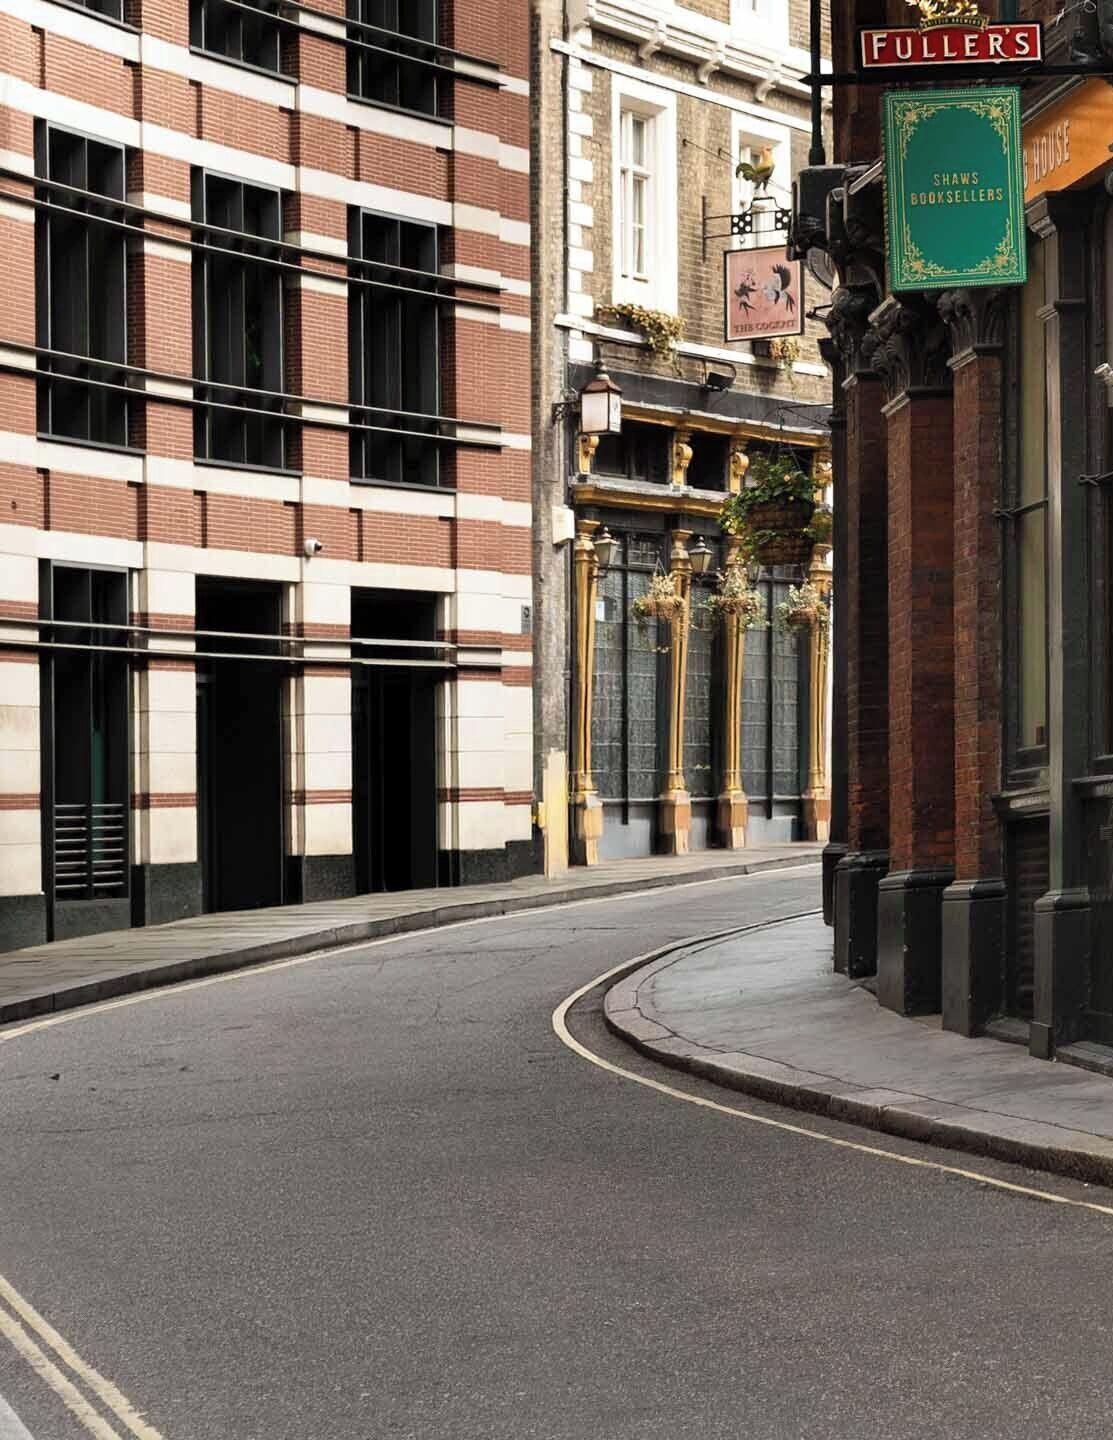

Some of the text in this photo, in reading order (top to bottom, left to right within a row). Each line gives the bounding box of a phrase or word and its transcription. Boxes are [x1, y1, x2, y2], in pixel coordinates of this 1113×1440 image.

[872, 28, 1031, 60] FULLER'S
[1033, 119, 1071, 184] HOUSE
[933, 171, 979, 186] SHAWS
[910, 188, 1004, 206] BOOKSELLERS
